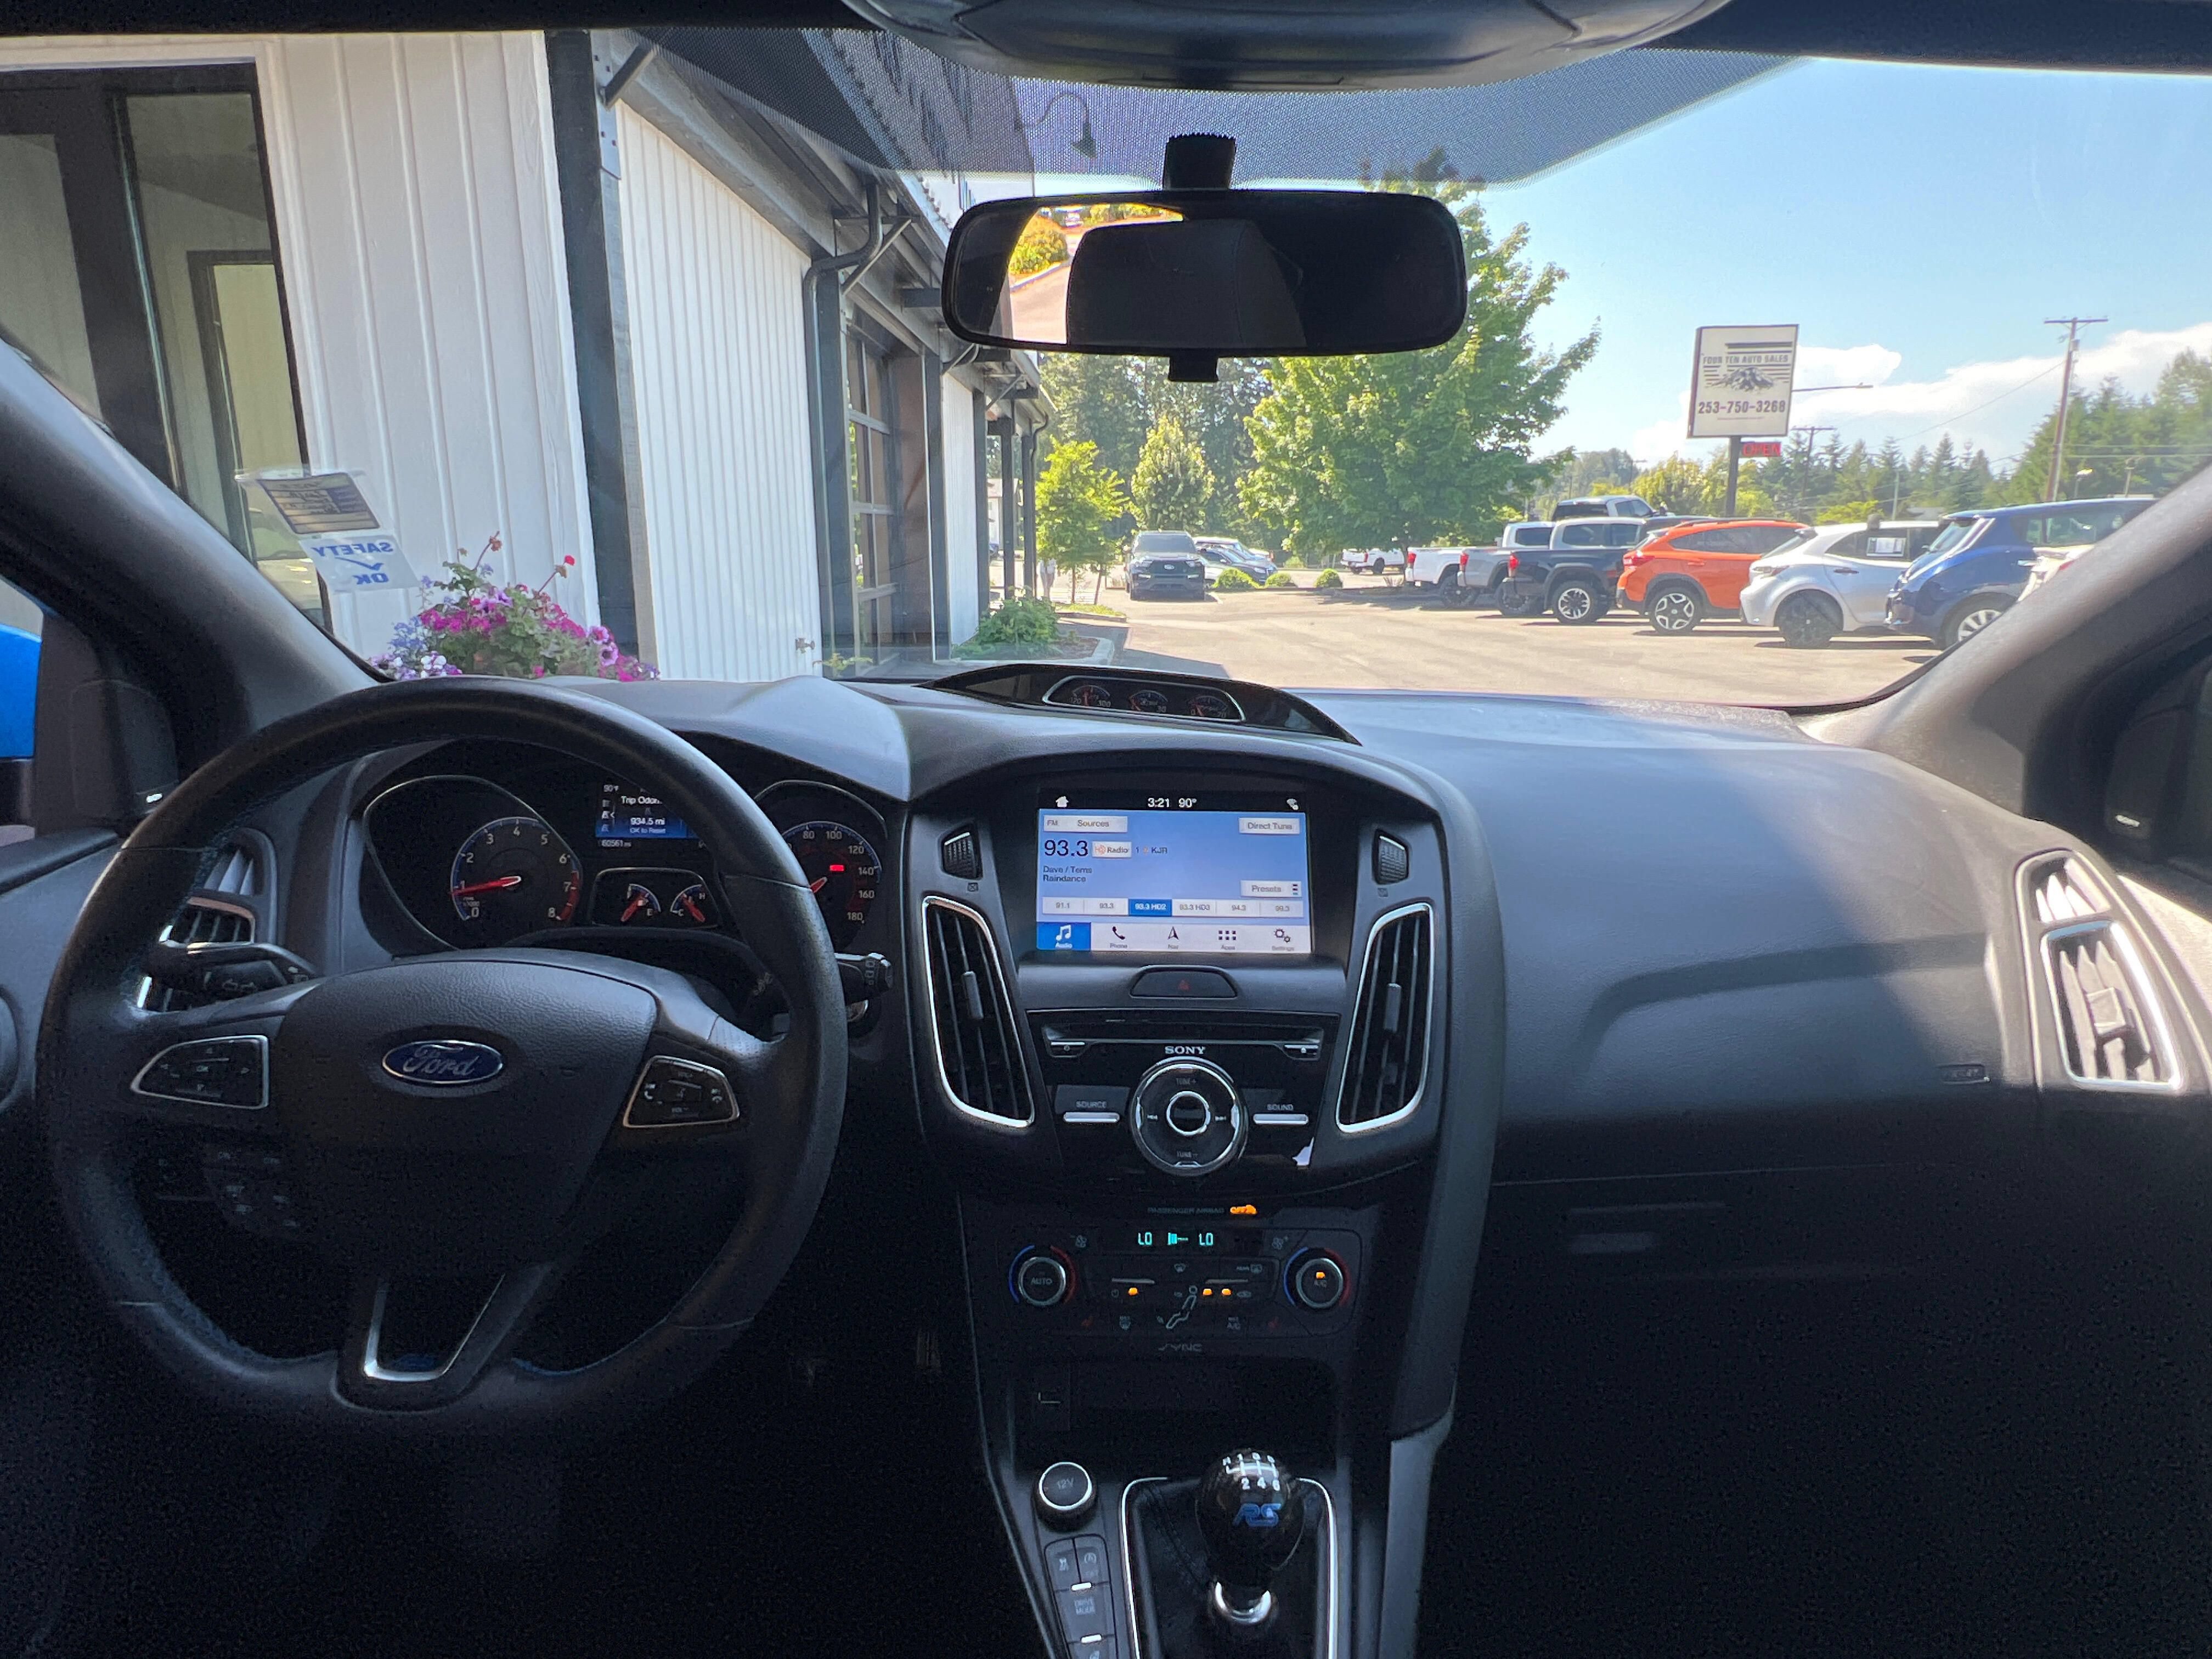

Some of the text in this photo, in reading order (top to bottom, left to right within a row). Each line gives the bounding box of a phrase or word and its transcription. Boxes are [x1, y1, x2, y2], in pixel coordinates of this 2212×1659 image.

[1725, 356, 1740, 364] TEN
[1742, 443, 1781, 457] OPEN
[620, 795, 636, 805] Trip
[1148, 798, 1170, 808] 3:21
[1178, 798, 1197, 808] 90°
[512, 826, 520, 836] 4
[802, 831, 815, 839] 80
[826, 831, 842, 839] 100
[486, 833, 494, 845] 3
[540, 834, 548, 845] 5
[848, 845, 865, 854] 120
[1045, 839, 1088, 857] 93.3
[466, 852, 474, 864] 2
[559, 853, 567, 864] 6
[858, 866, 874, 875] 140
[563, 881, 571, 893] 7
[859, 890, 874, 899] 160
[471, 906, 479, 917] 0
[548, 907, 556, 918] 8
[847, 912, 863, 921] 180
[1165, 1046, 1206, 1055] SONY
[403, 1043, 482, 1076] Ford
[1030, 1277, 1053, 1285] AUTO
[1232, 1503, 1282, 1527] RS
